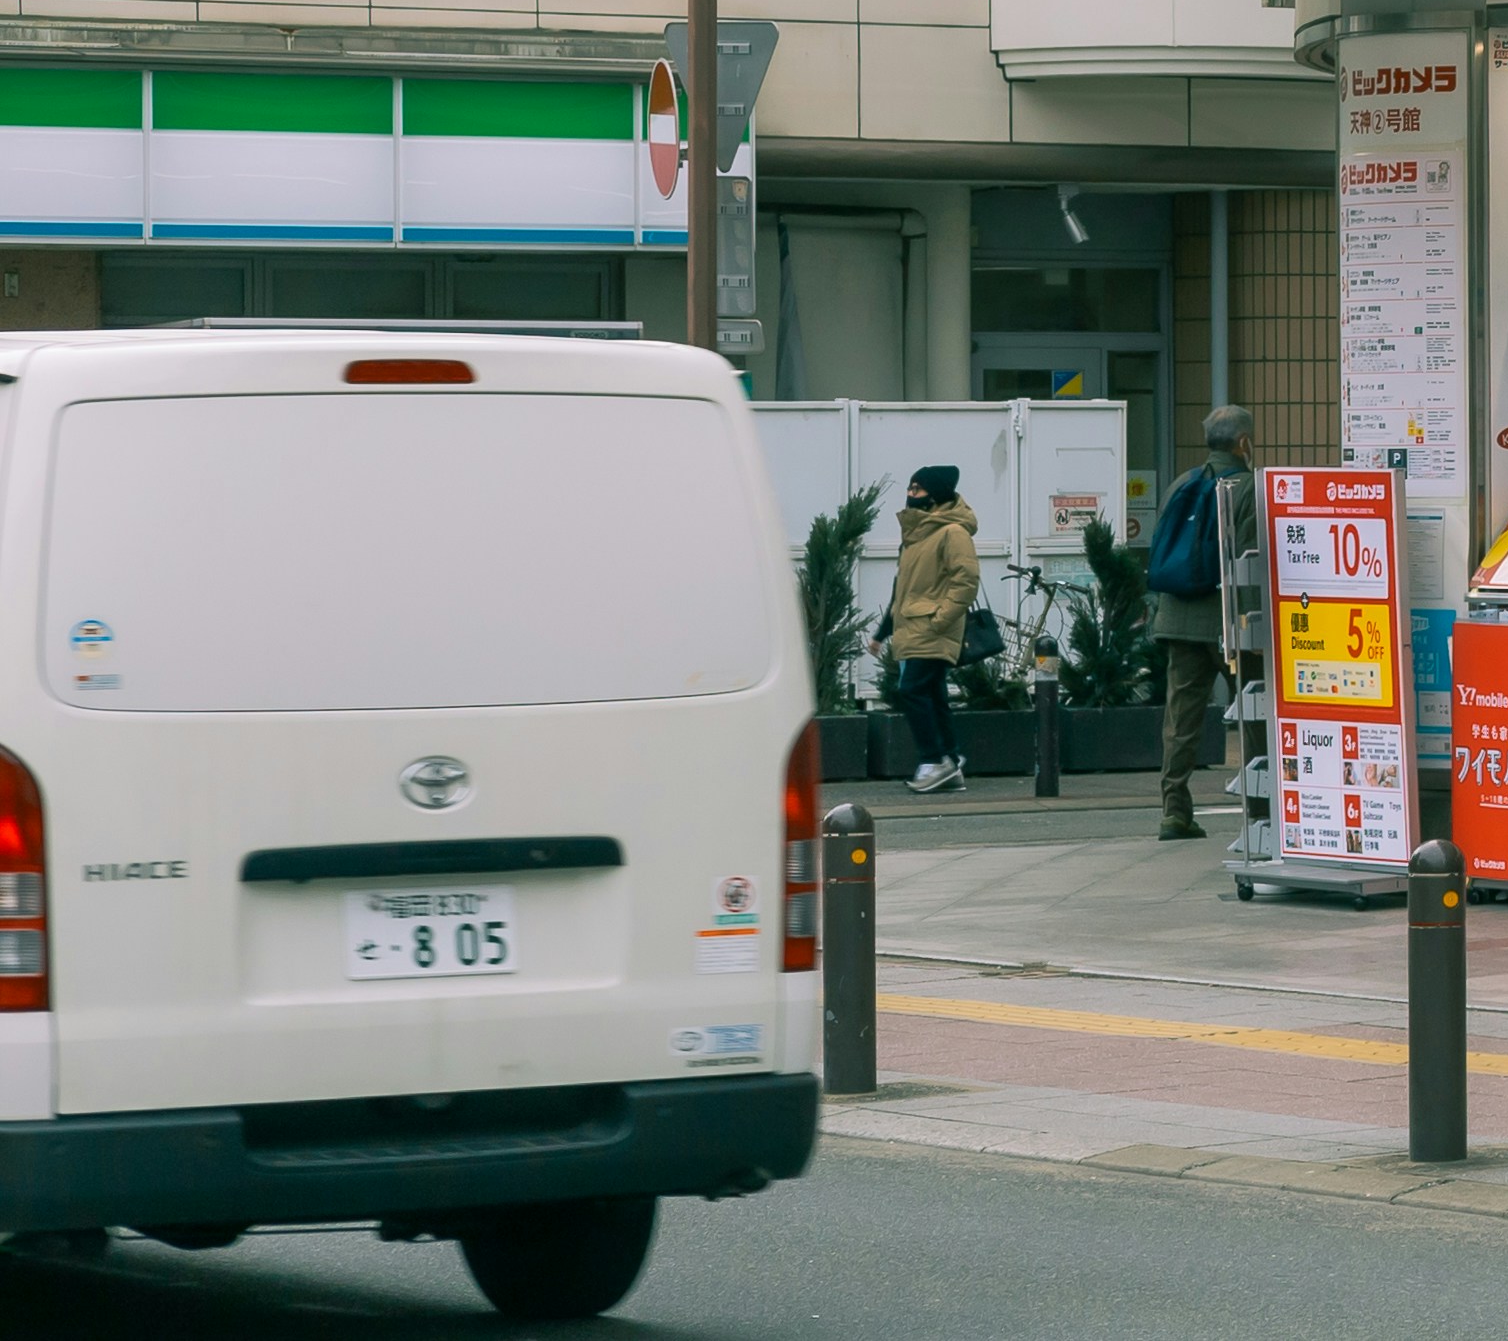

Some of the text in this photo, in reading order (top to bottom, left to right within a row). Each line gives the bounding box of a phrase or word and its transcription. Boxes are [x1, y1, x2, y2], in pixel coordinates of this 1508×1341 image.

[1352, 65, 1457, 95] ビックカメラ
[1348, 161, 1418, 186] ビックカメラ
[1337, 484, 1385, 500] ビックカメラ
[1329, 523, 1382, 578] 10%
[1291, 636, 1325, 651] Discount
[1302, 730, 1333, 750] Liquor
